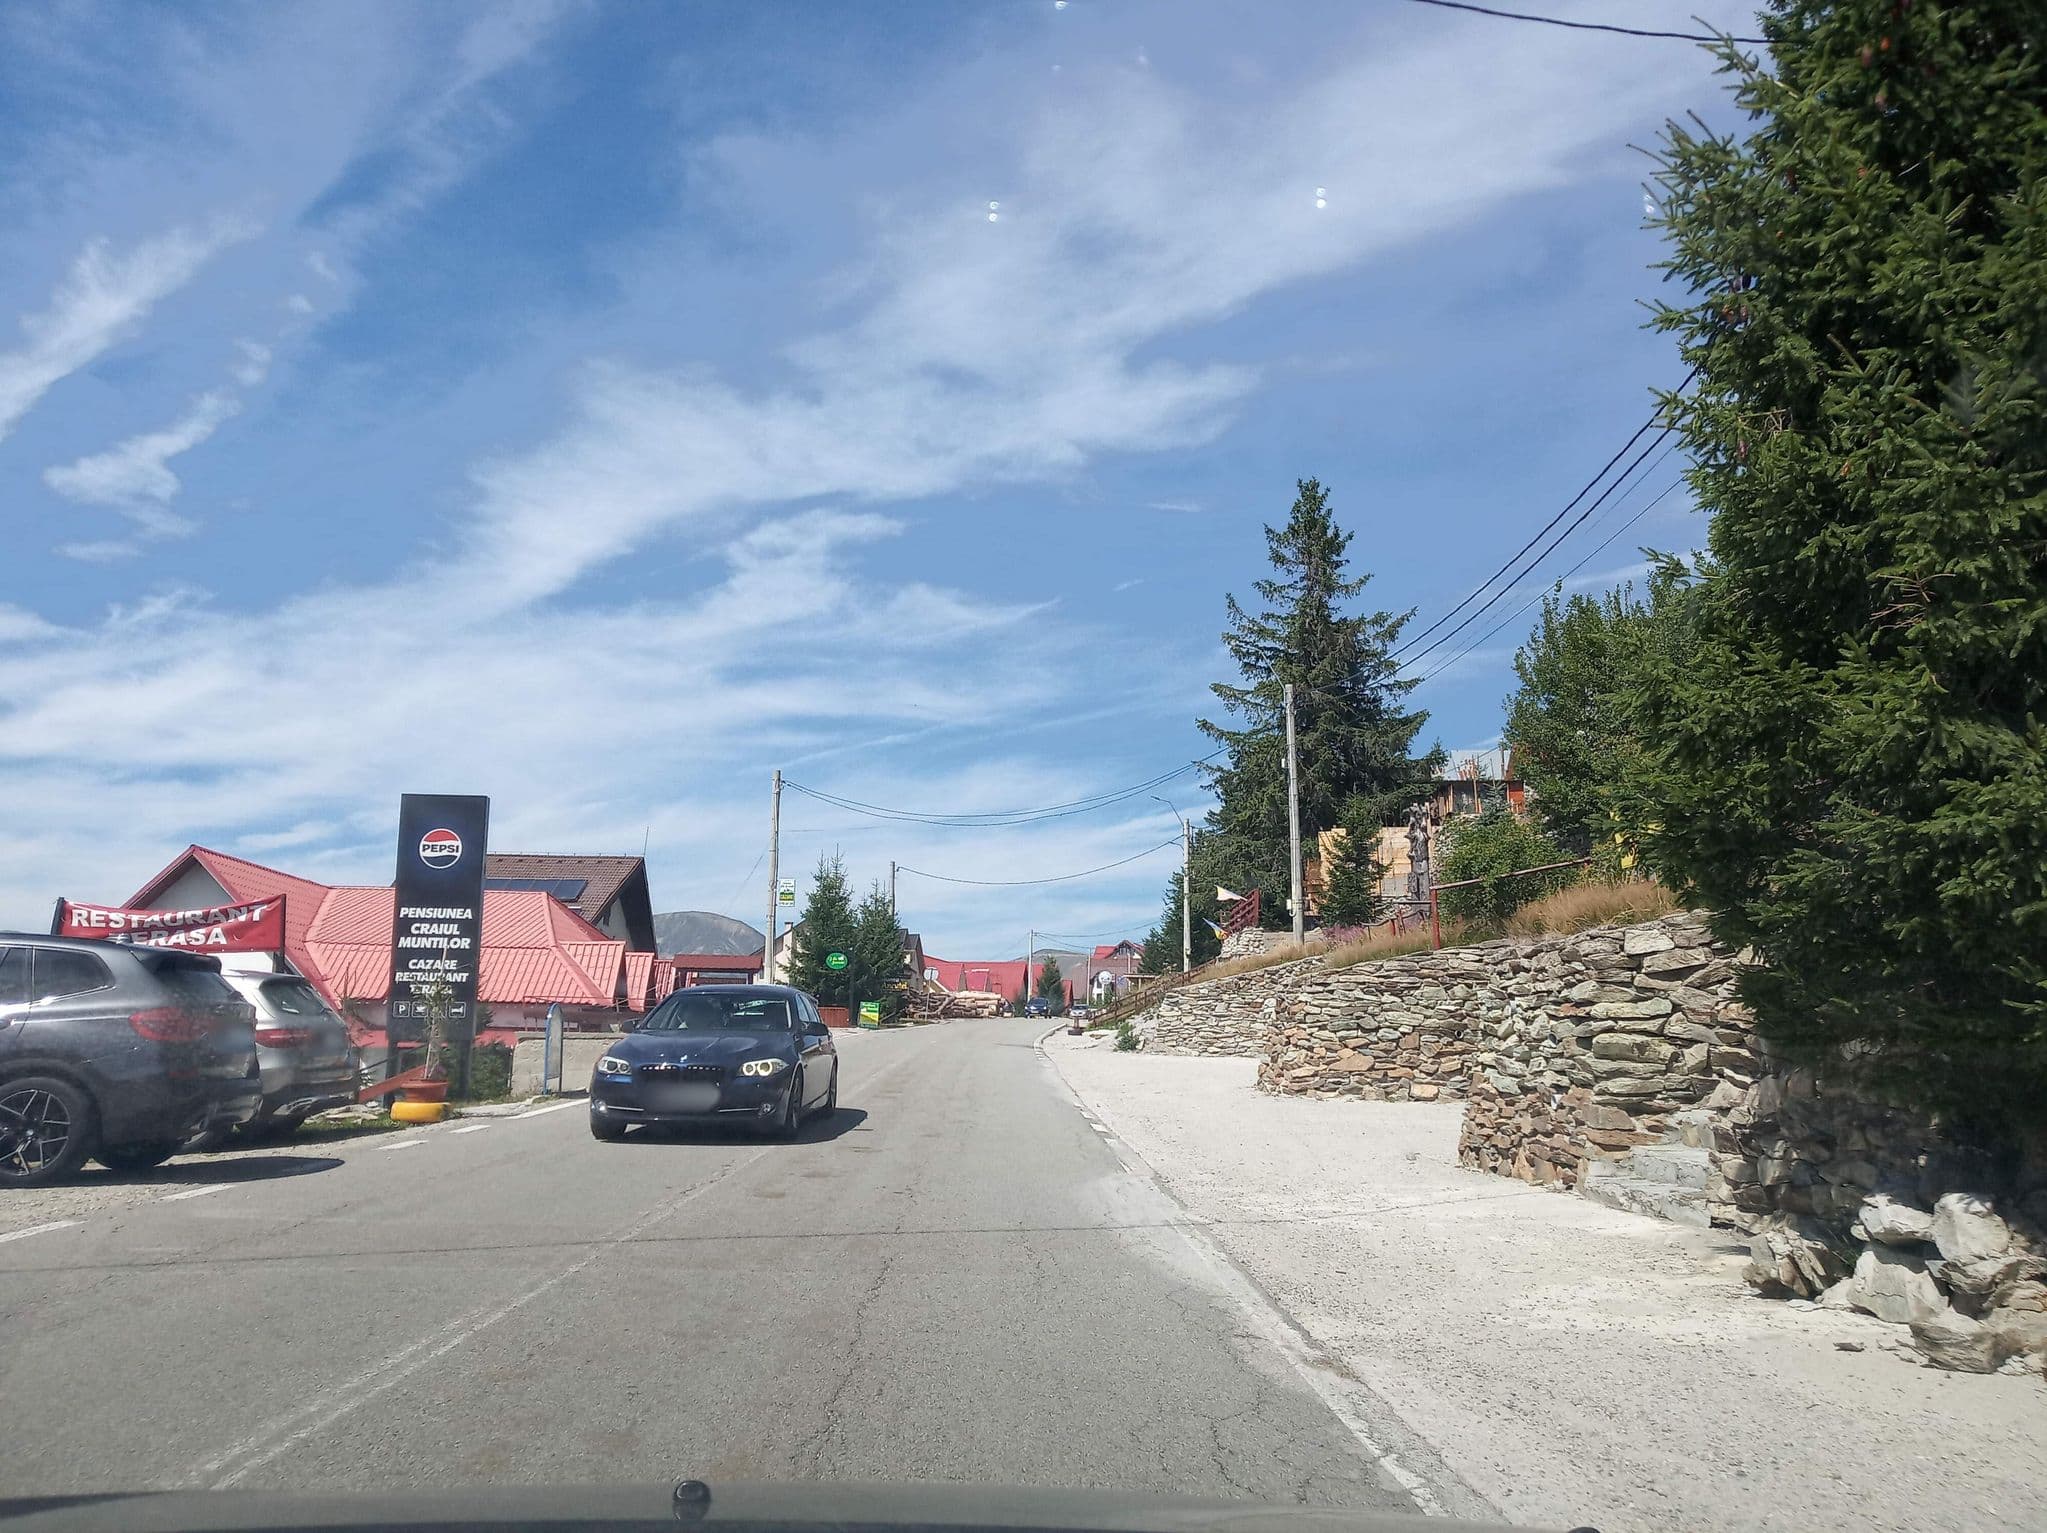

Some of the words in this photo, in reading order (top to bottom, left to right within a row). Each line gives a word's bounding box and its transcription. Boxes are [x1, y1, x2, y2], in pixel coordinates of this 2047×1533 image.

[422, 844, 460, 853] PEPSI
[71, 904, 268, 929] RESTAURANT
[399, 907, 473, 919] PENSIUNEA
[410, 923, 460, 935] CRAIUL
[397, 937, 471, 949] MUNTILOR
[408, 959, 458, 970] CAZARE
